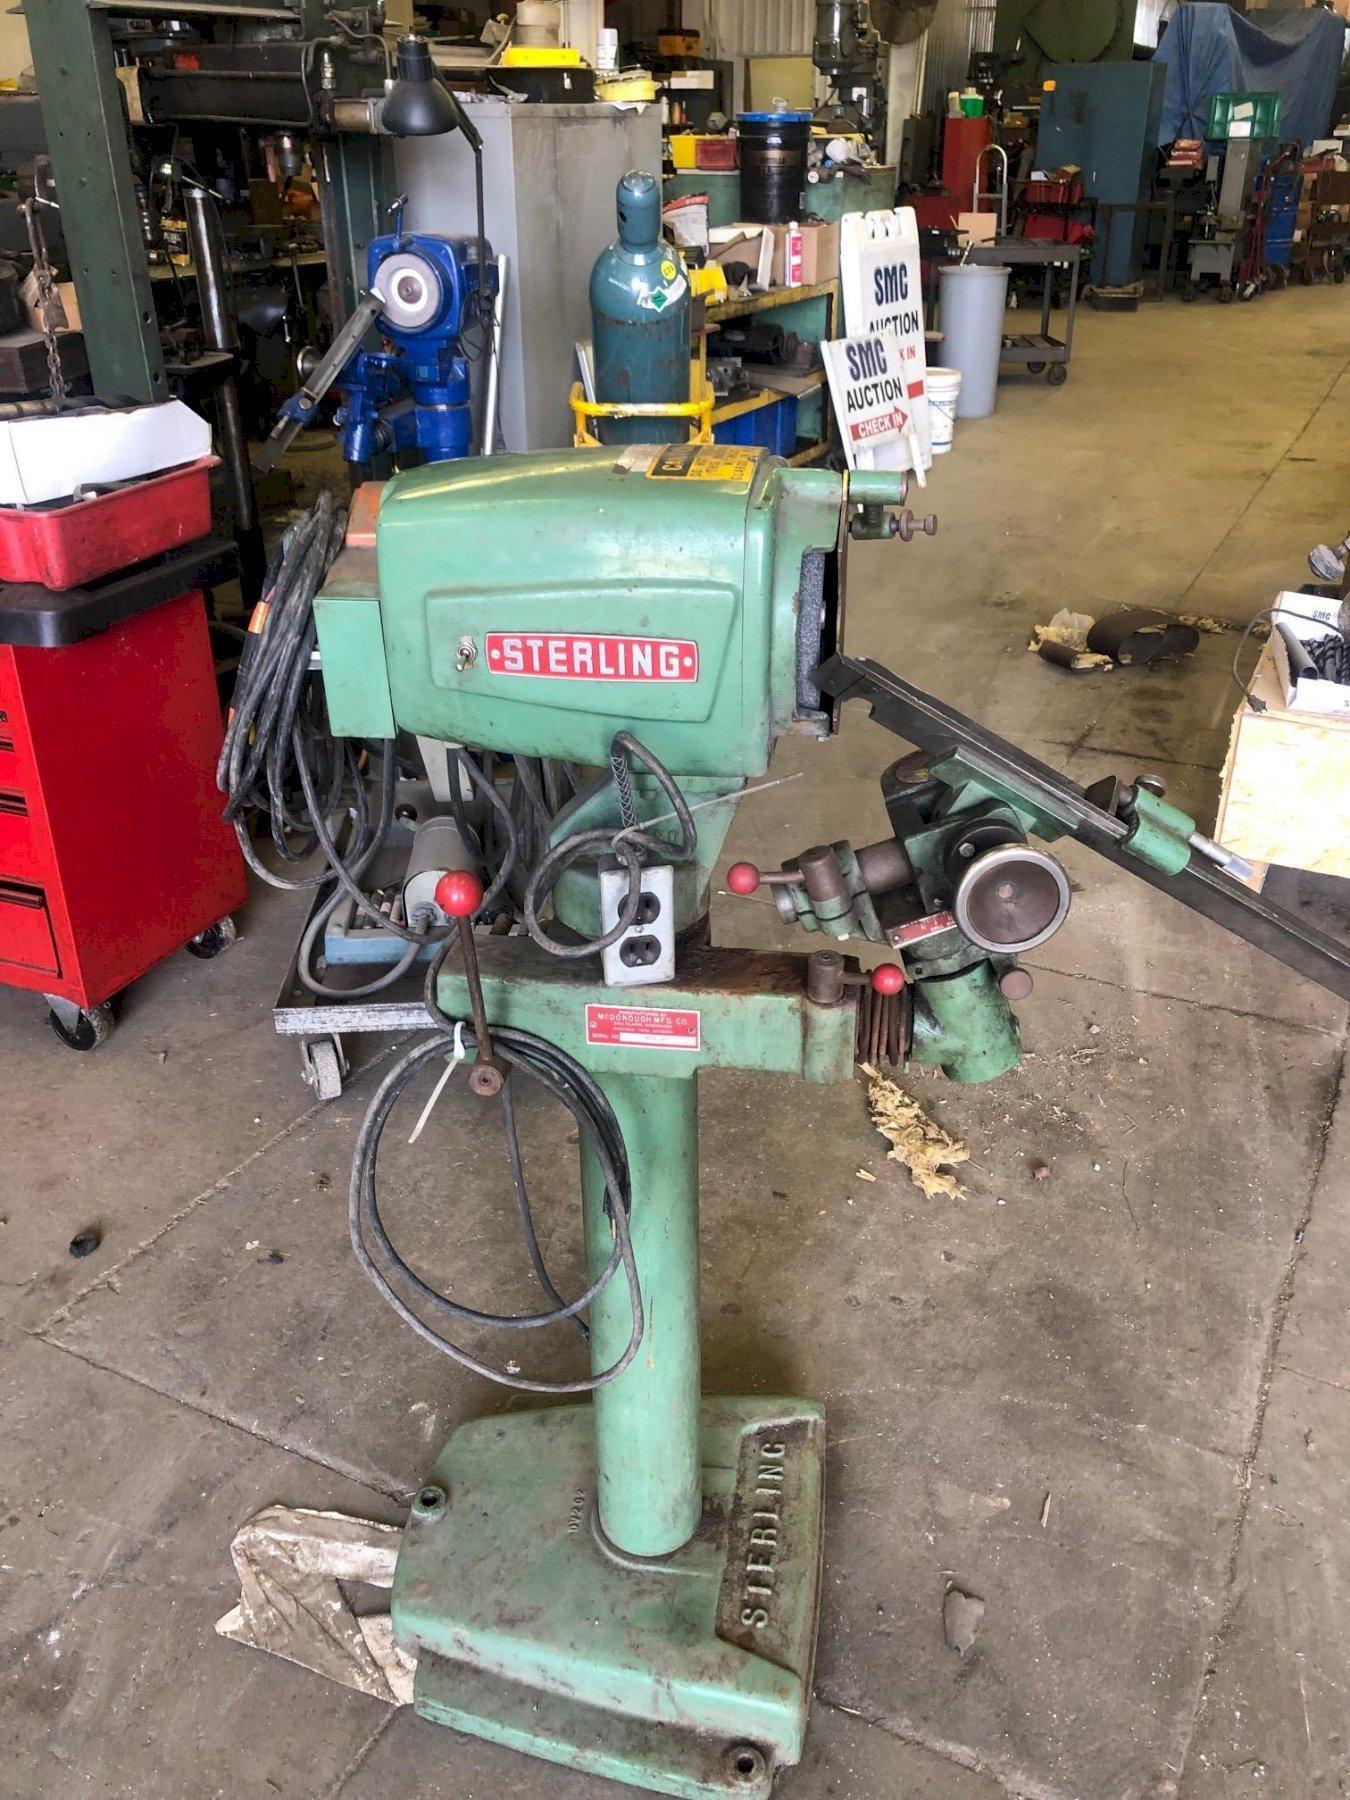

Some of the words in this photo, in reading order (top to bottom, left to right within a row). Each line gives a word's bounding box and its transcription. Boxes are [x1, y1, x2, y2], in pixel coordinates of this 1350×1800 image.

[874, 262, 909, 306] SMC
[846, 338, 888, 382] SMC
[846, 377, 903, 413] AUCTION
[858, 415, 891, 438] CHECK
[892, 411, 904, 428] IN
[1312, 610, 1332, 621] SMC
[502, 638, 680, 678] STERLING
[741, 1443, 786, 1628] STERLING
